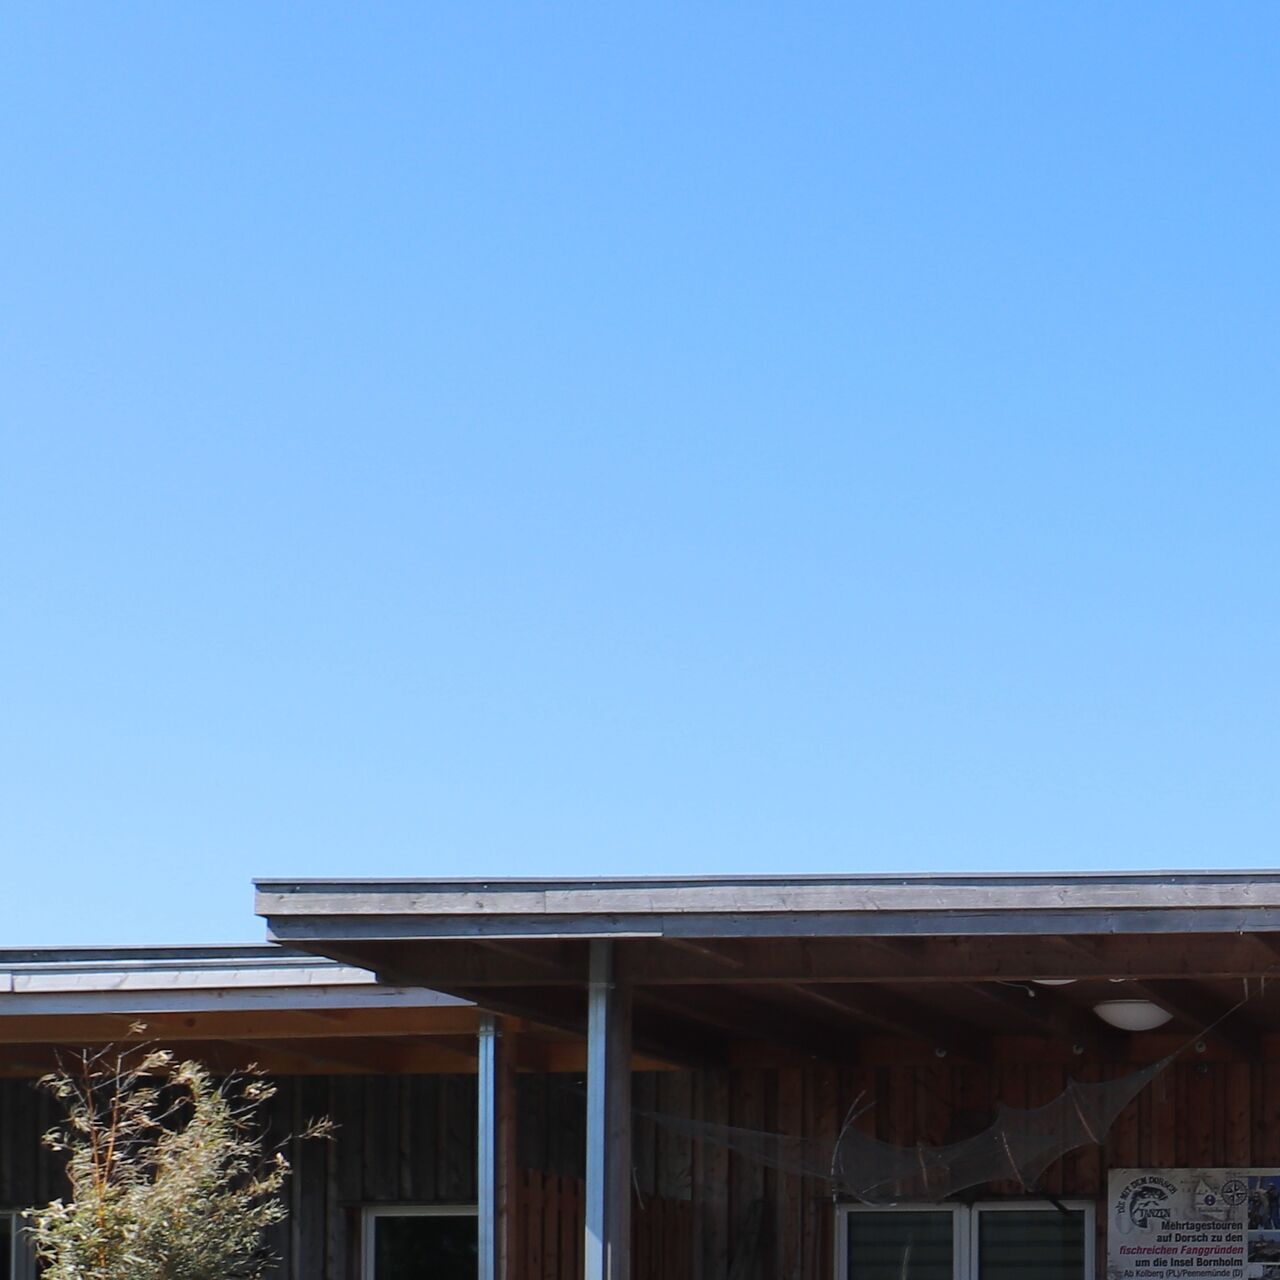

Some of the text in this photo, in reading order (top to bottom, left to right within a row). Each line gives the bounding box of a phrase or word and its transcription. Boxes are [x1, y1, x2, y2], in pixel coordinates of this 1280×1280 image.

[1149, 1176, 1178, 1195] DORSCH
[1161, 1221, 1243, 1232] Mehrtagestouren
[1156, 1233, 1243, 1243] auf Dorsch zu den
[1119, 1245, 1244, 1257] fischreichen Fanggründen
[1135, 1257, 1243, 1267] um die Insel Bornholm
[1124, 1269, 1134, 1277] Ab
[1135, 1269, 1164, 1279] Kolberg
[1232, 1269, 1243, 1278] (D)
